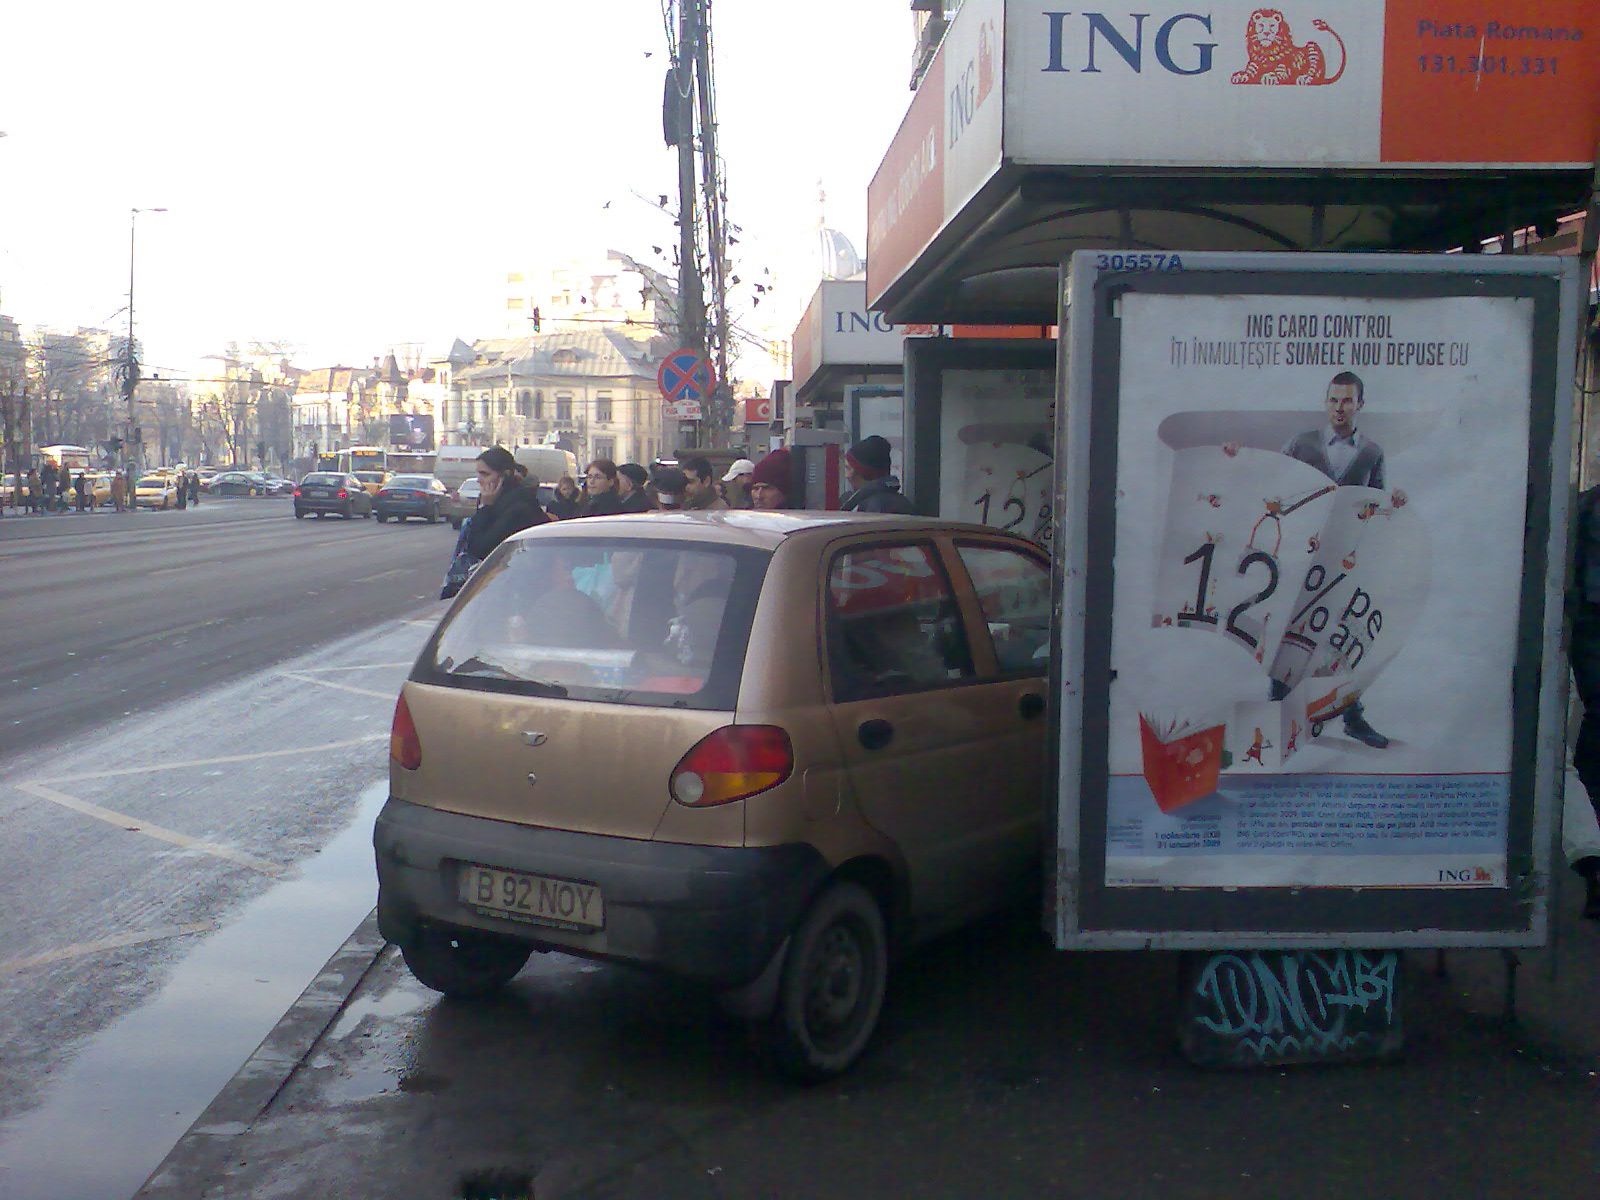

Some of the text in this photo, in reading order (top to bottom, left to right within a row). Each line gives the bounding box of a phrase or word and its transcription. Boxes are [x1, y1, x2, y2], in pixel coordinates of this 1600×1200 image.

[1041, 10, 1218, 75] ING
[1486, 19, 1585, 41] Romana
[949, 61, 975, 149] ING
[1096, 253, 1184, 272] 30557A
[1246, 314, 1393, 339] ING CARD CONT'ROL
[1286, 341, 1346, 366] SUMELE
[1351, 341, 1381, 366] NOU
[1386, 341, 1445, 366] DEPUSE
[1449, 341, 1470, 366] CU
[1438, 869, 1470, 882] ING
[477, 871, 495, 903] B
[502, 876, 533, 911] 92
[538, 882, 595, 921] NOY
